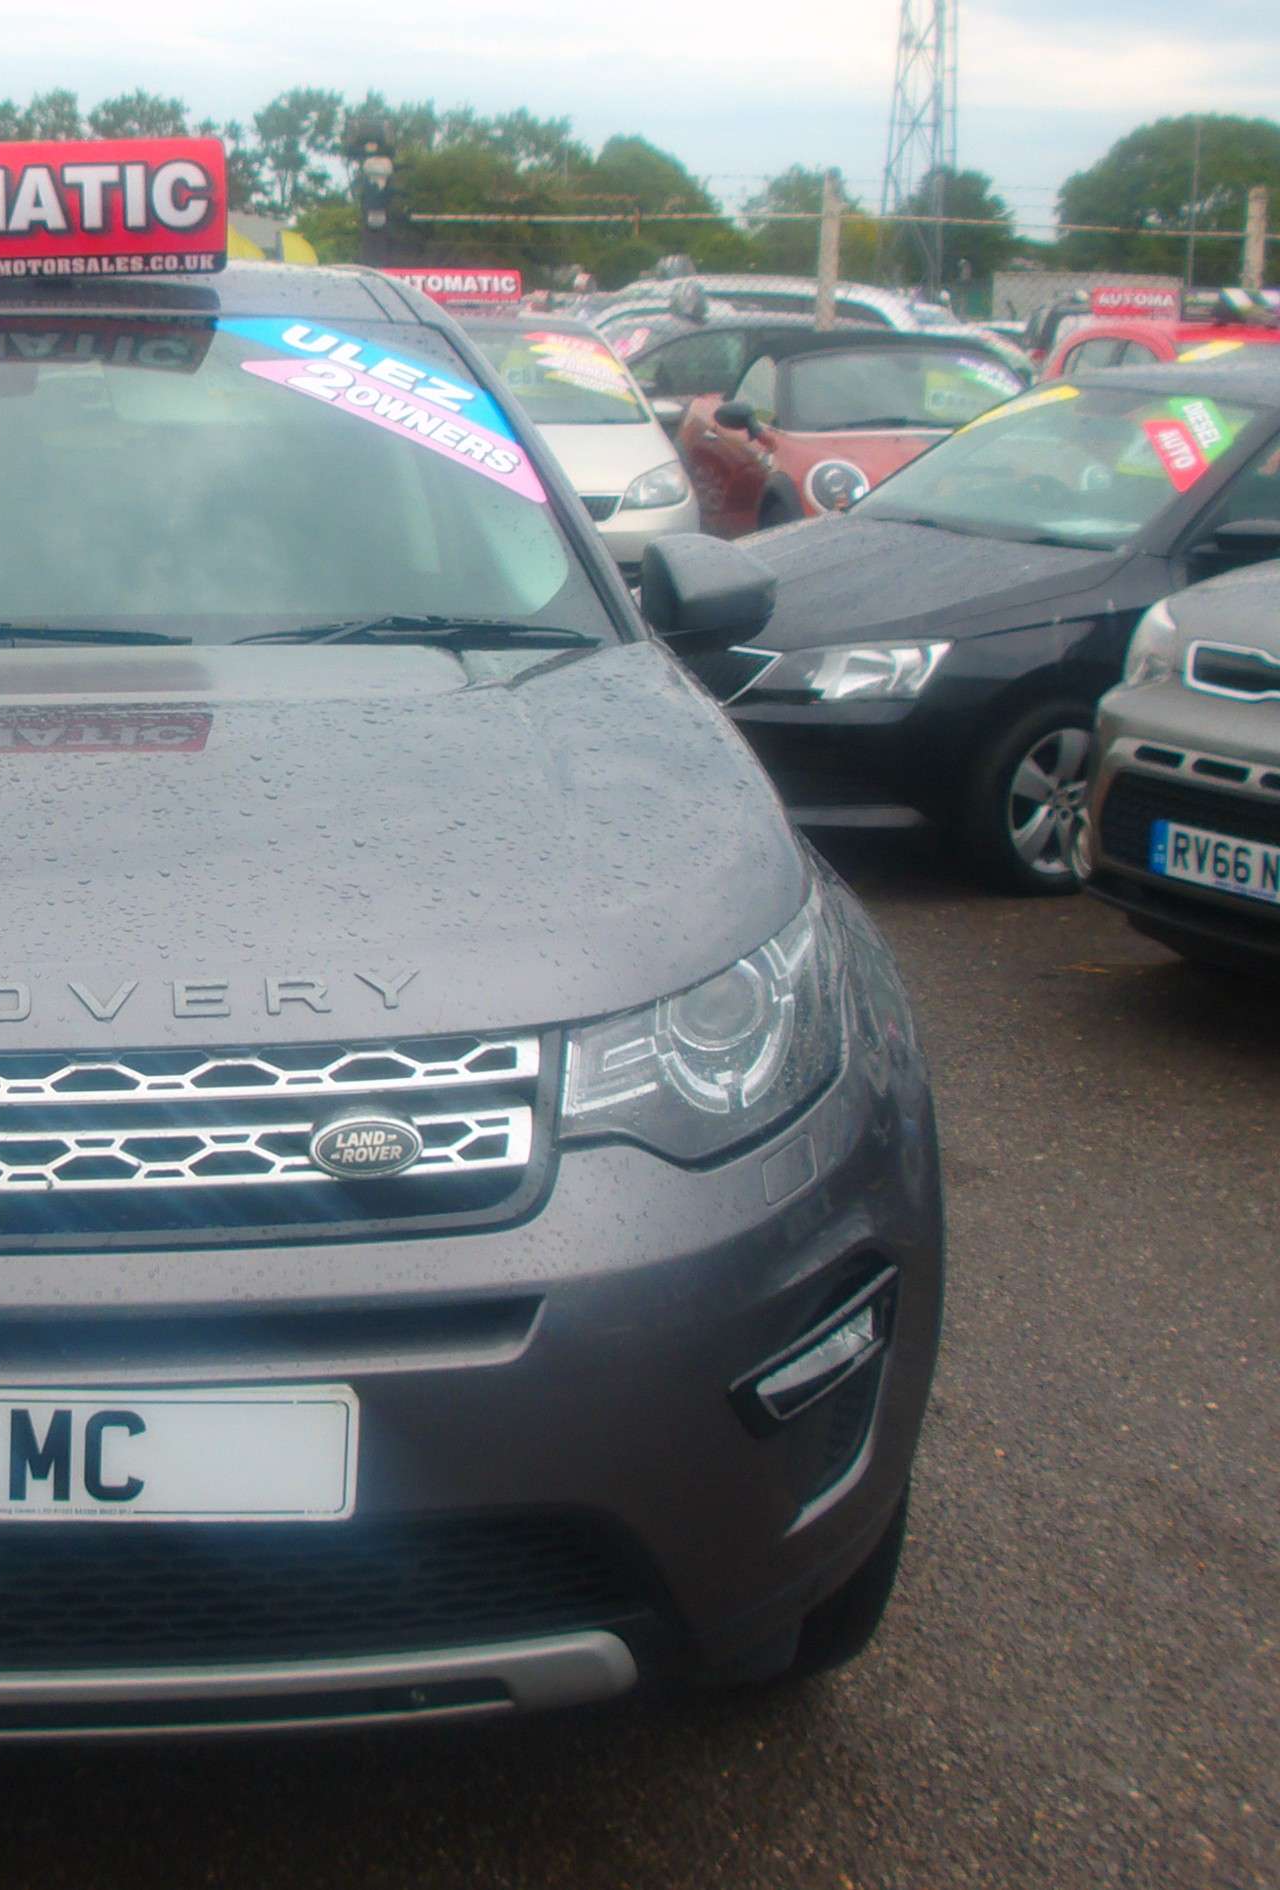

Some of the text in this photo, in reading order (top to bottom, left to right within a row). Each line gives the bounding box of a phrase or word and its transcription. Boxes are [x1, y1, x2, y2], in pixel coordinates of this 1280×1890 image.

[1098, 293, 1175, 307] AUTOMA
[281, 324, 476, 413] ULEZ
[285, 362, 522, 475] 2 OWNERS
[1182, 401, 1221, 449] DIESEL
[1157, 428, 1197, 469] AUTO
[1172, 831, 1252, 884] RV66
[335, 1130, 386, 1148] LAND
[340, 1145, 403, 1163] ROVER
